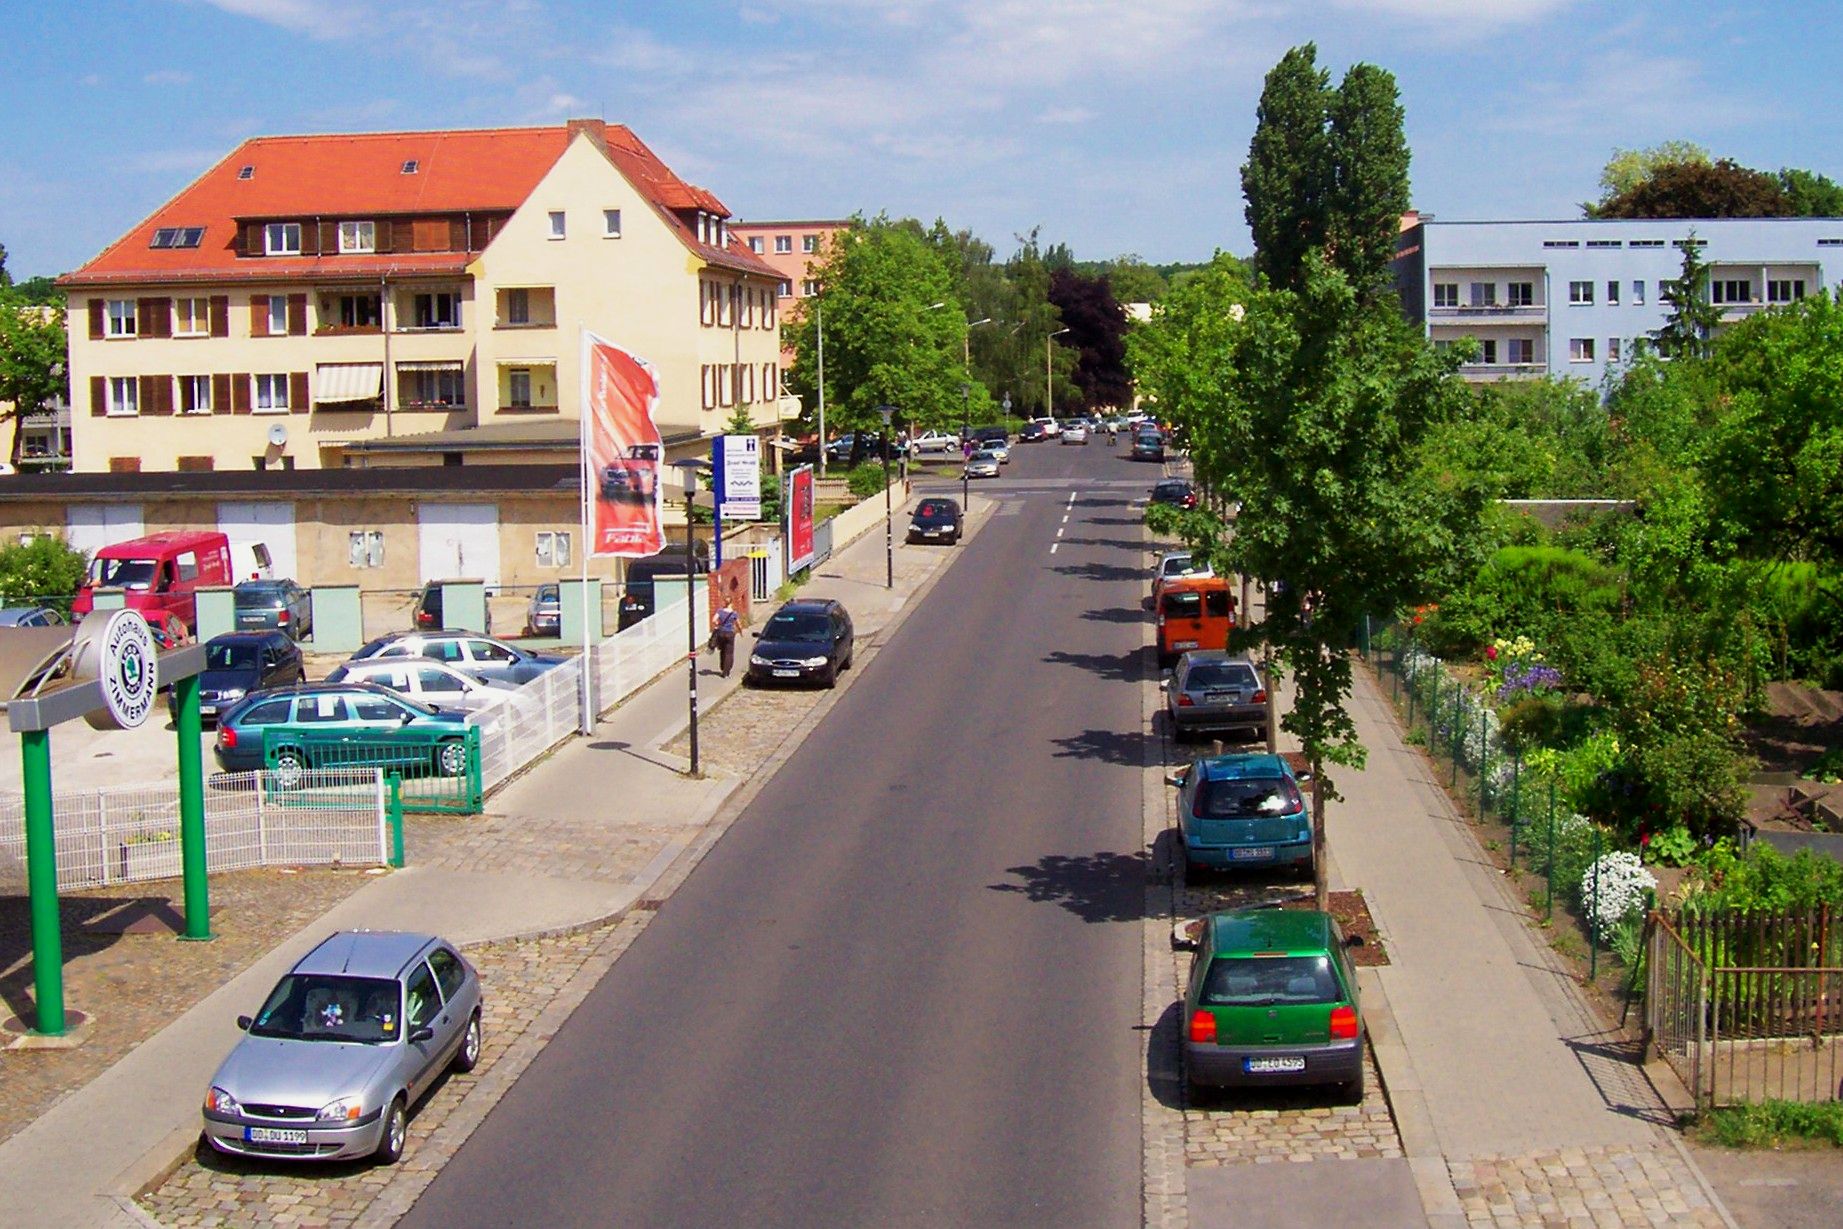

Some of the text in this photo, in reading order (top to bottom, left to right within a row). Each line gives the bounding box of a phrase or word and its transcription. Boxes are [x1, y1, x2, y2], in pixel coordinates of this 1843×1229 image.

[110, 619, 148, 656] Autohaus
[109, 662, 154, 720] ZIMMERMANN
[283, 1131, 305, 1141] 1199
